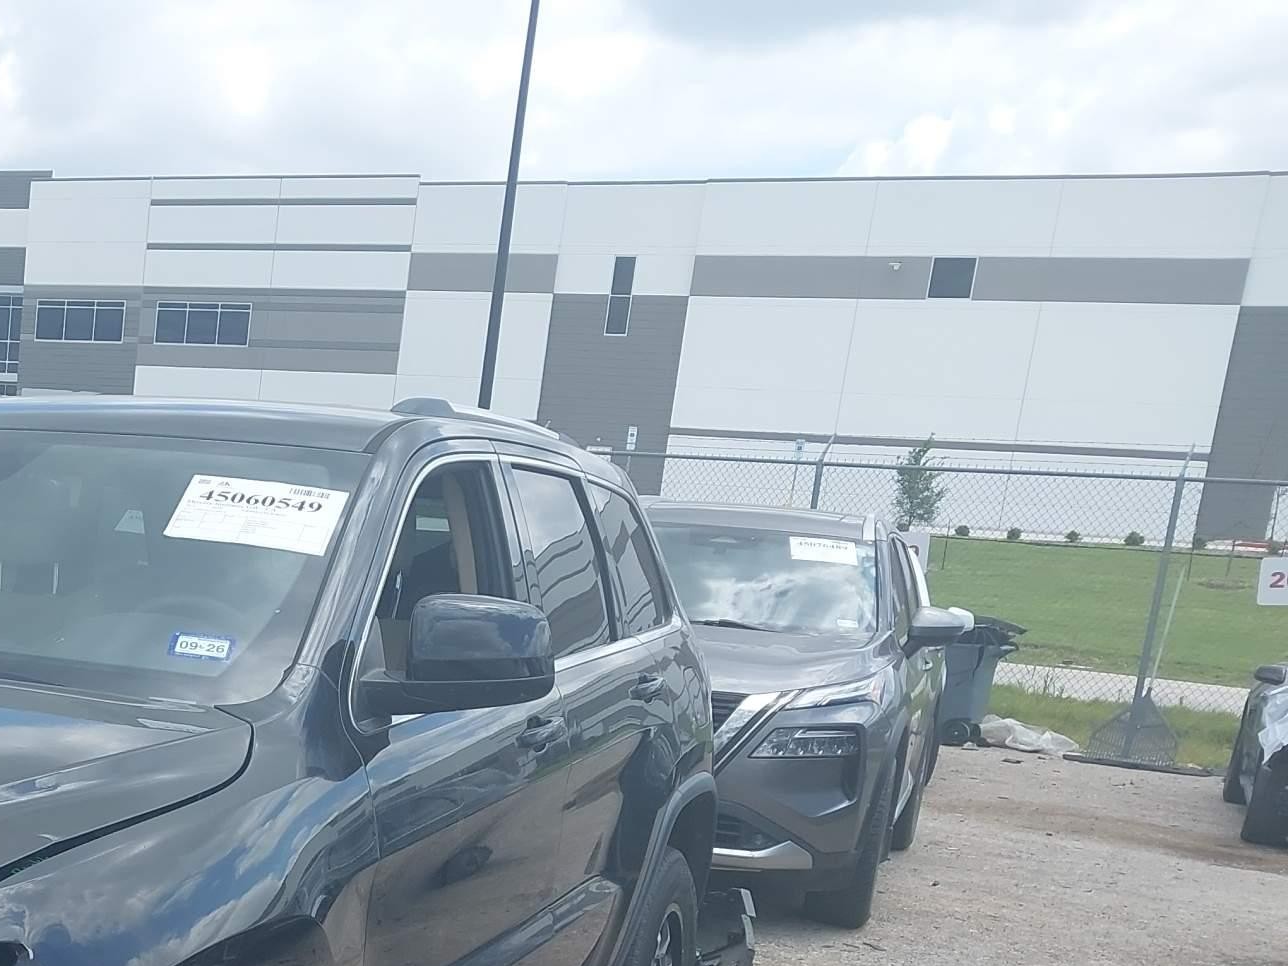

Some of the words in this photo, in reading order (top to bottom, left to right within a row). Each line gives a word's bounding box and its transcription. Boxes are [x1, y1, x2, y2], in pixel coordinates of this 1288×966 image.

[199, 489, 323, 513] 45060549
[1269, 571, 1288, 589] 2
[205, 643, 225, 654] 26
